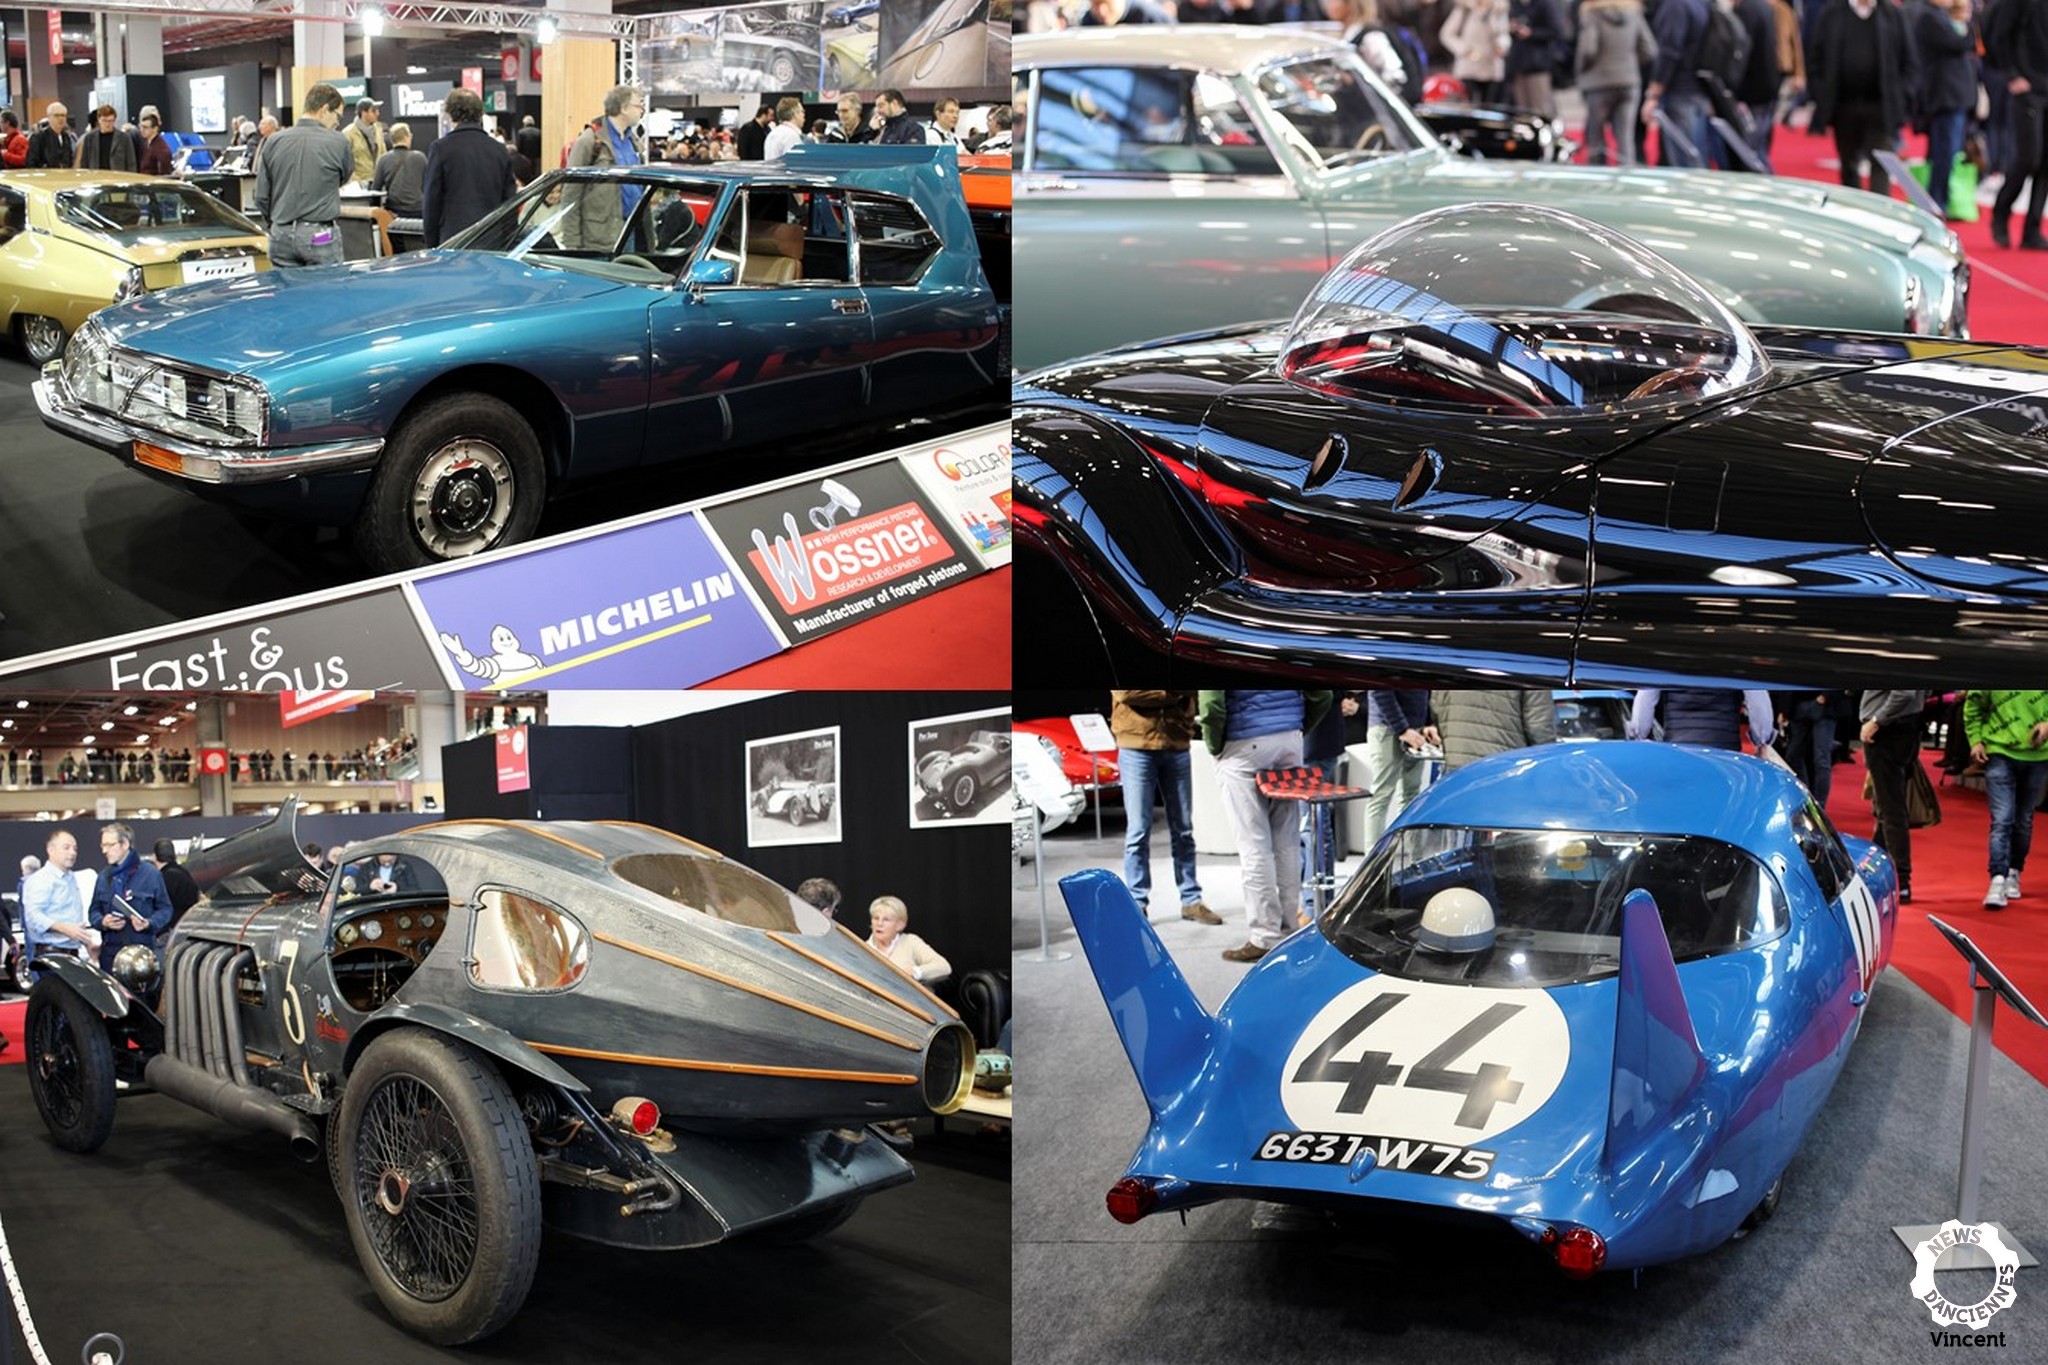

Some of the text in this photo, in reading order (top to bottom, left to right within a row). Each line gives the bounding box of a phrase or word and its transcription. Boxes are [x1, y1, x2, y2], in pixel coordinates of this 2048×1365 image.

[839, 516, 891, 539] PERFORMANCE
[889, 507, 918, 523] PISTONS
[793, 562, 967, 634] Manufacturer of forged pistons
[827, 575, 867, 596] RESEARCH
[873, 556, 922, 580] DEVELOPMENT
[540, 572, 735, 655] MICHELIN
[110, 627, 283, 690] Fast &
[1291, 992, 1527, 1131] 44
[1260, 1133, 1363, 1164] 6631
